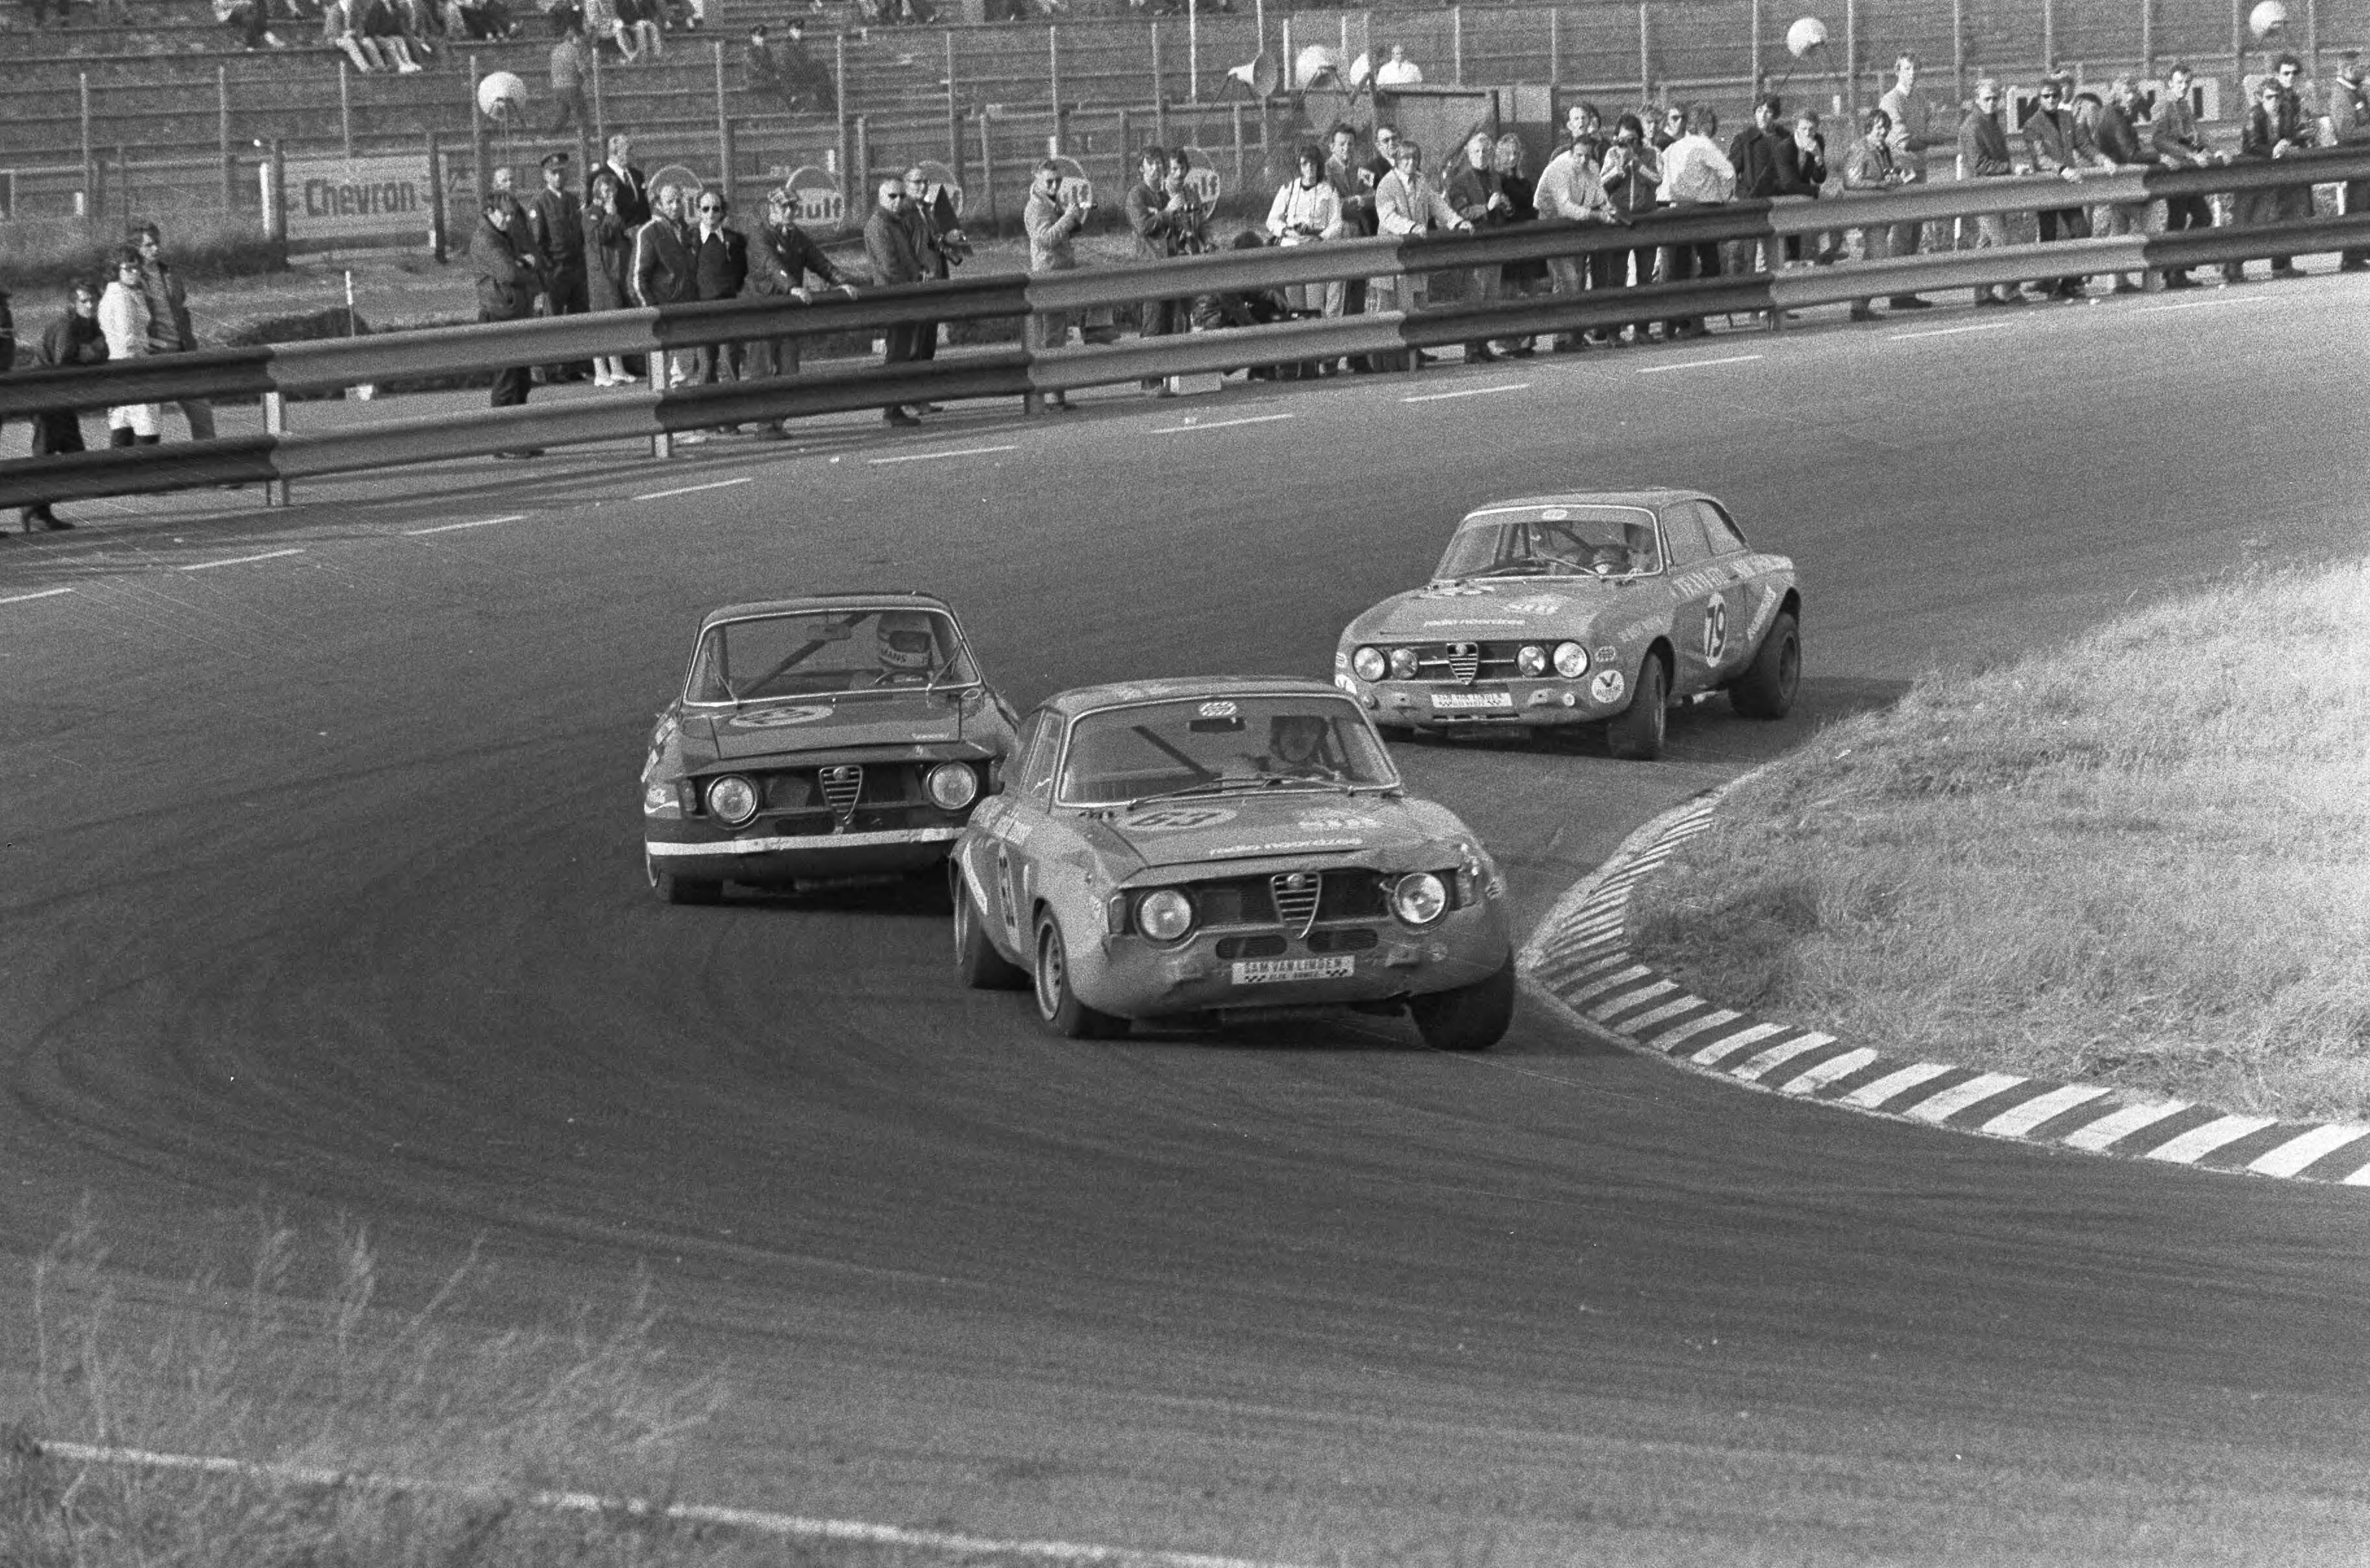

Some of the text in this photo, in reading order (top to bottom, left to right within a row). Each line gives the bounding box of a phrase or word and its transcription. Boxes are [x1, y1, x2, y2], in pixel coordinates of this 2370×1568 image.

[305, 178, 416, 216] Chevron
[795, 197, 841, 219] ulf
[1706, 603, 1726, 657] 79
